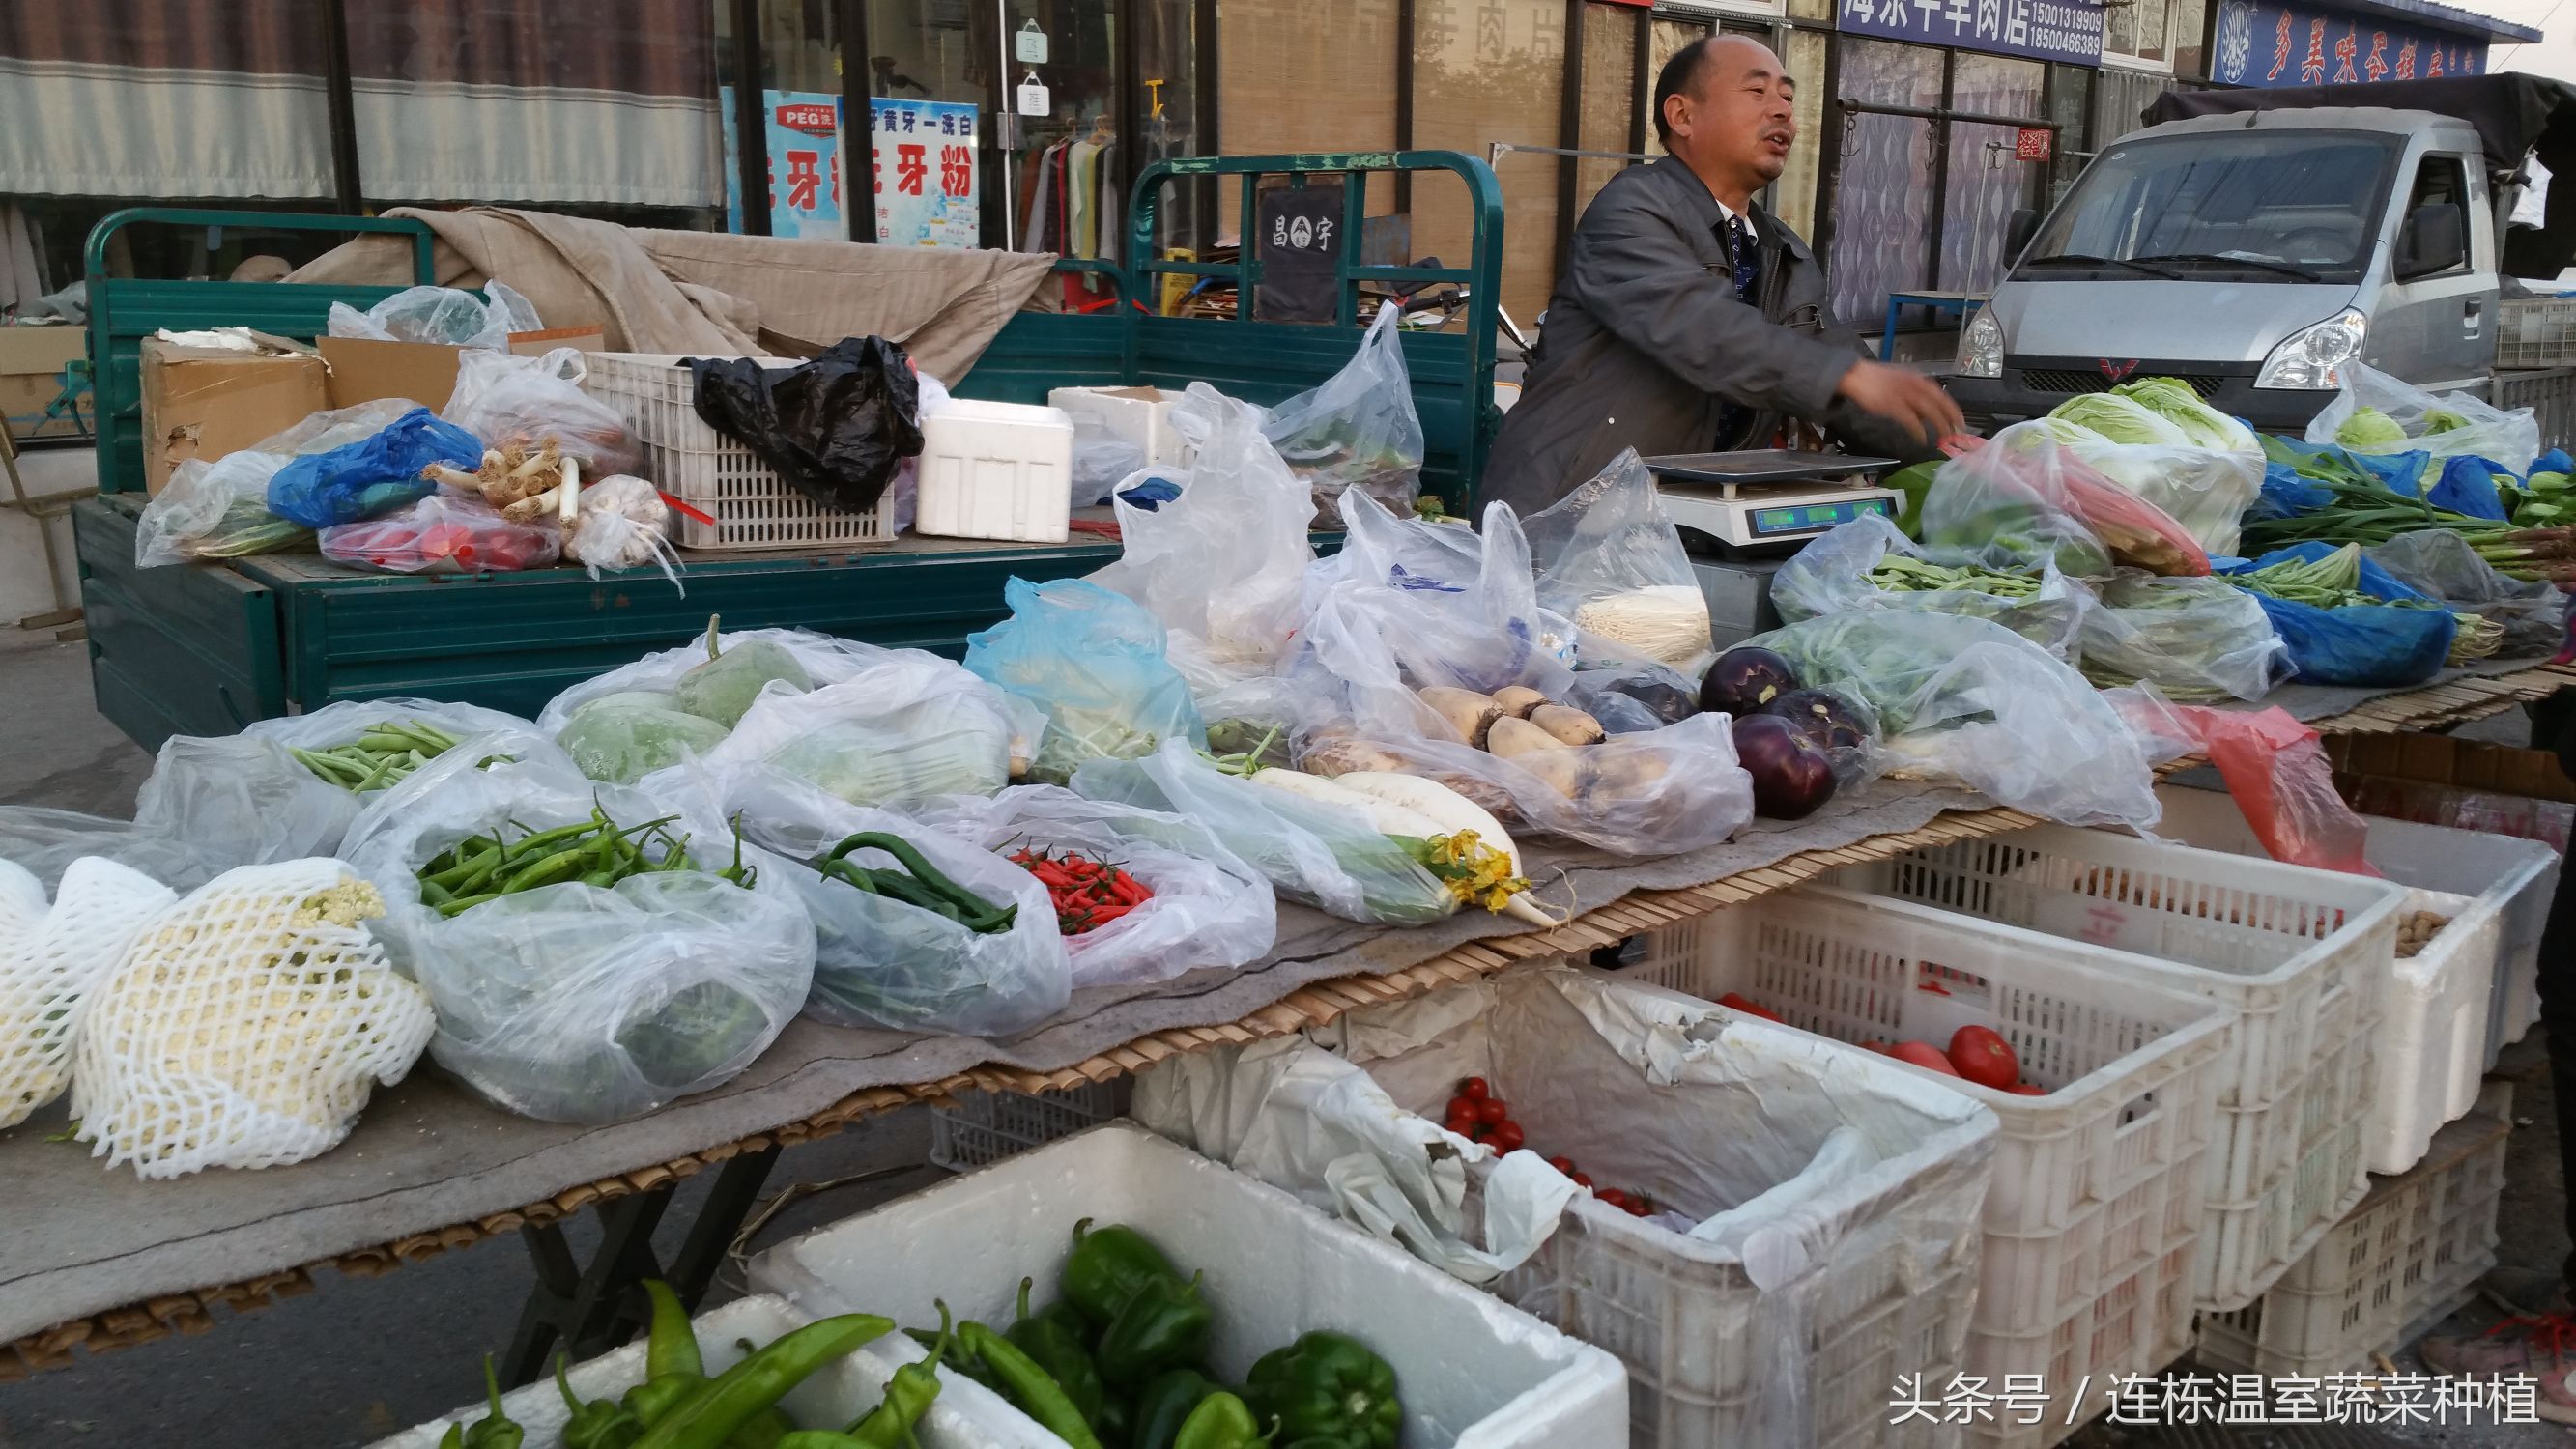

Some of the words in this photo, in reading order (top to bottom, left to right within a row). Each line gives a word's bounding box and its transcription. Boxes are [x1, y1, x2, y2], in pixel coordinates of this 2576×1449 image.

[2032, 1, 2103, 33] 15001319909
[2030, 25, 2101, 56] 18500466389
[787, 111, 819, 126] PEG
